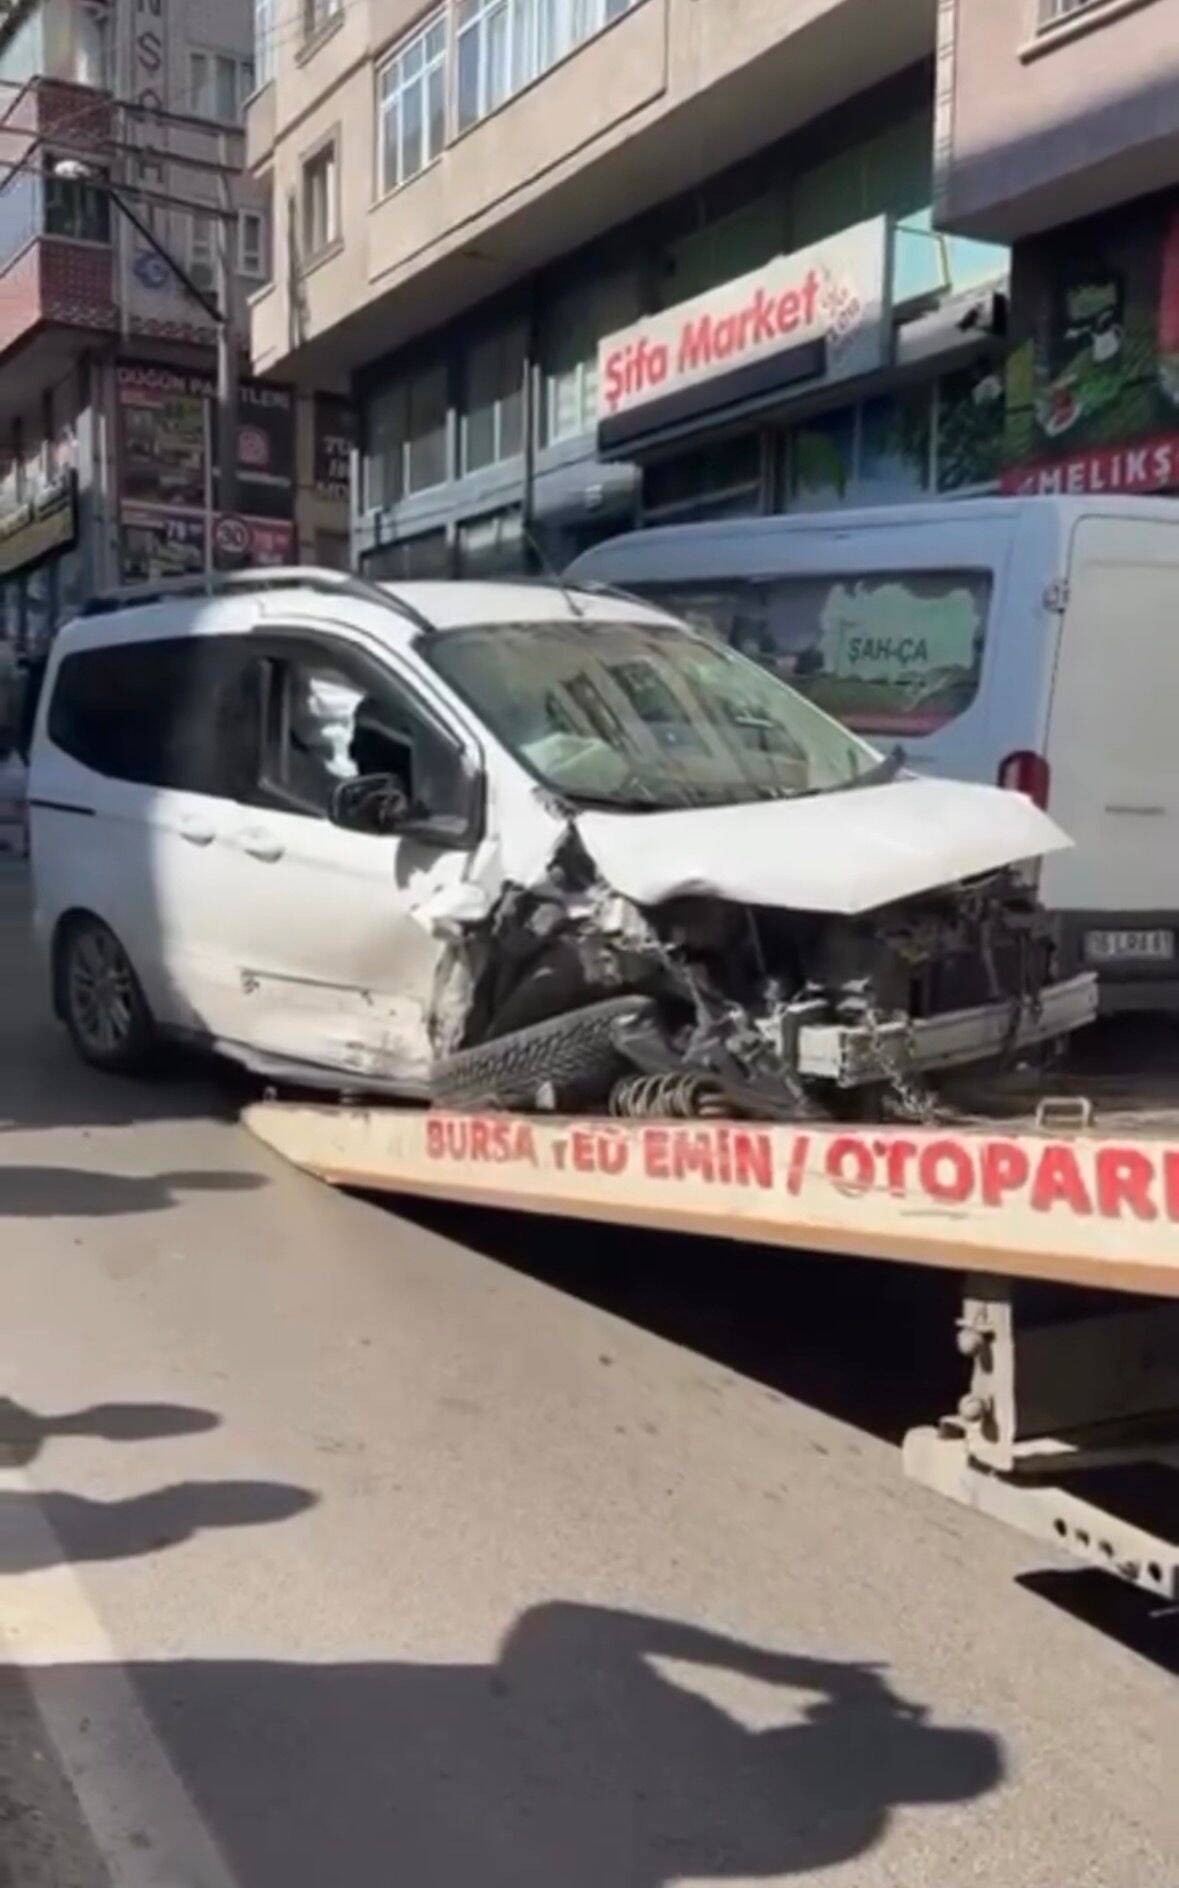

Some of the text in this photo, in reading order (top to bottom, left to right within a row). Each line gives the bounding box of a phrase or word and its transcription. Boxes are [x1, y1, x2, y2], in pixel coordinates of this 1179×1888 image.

[604, 337, 669, 412] Şifa
[676, 268, 819, 374] Market
[426, 1119, 540, 1168] BURSA
[643, 1127, 773, 1189] EMİN
[786, 1135, 810, 1197] /
[825, 1137, 1179, 1222] OTOPAR
